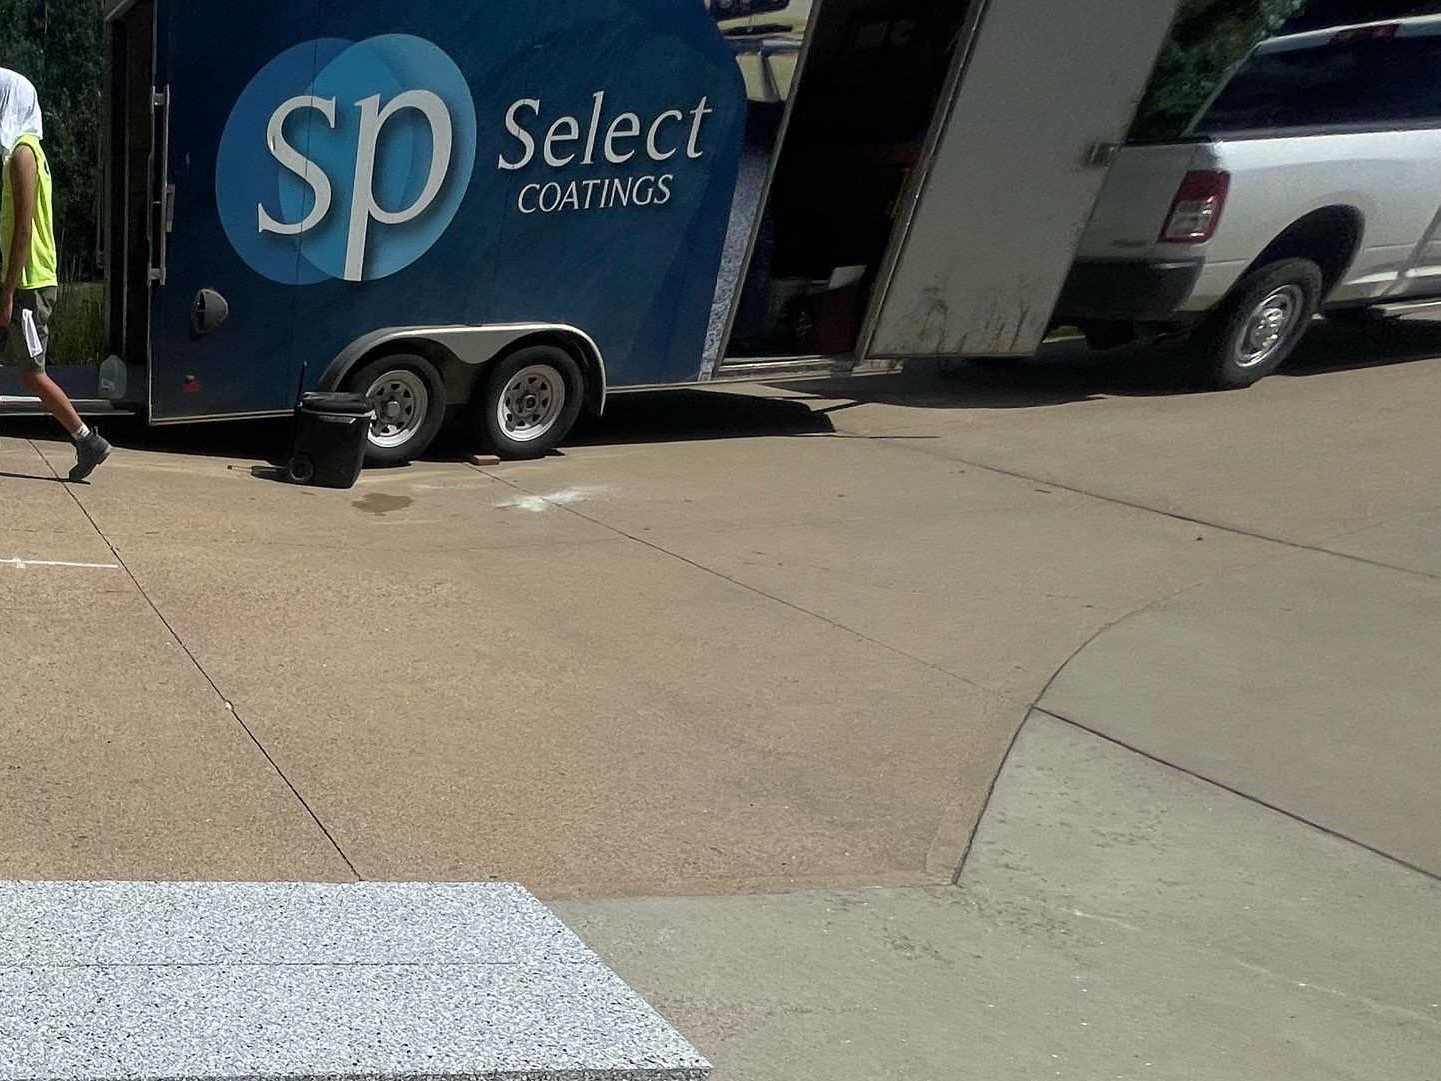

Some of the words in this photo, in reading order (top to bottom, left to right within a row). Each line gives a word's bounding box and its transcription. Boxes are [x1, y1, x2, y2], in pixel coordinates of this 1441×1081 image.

[497, 90, 712, 170] Select
[258, 89, 453, 281] sp
[517, 174, 674, 214] COATINGS
